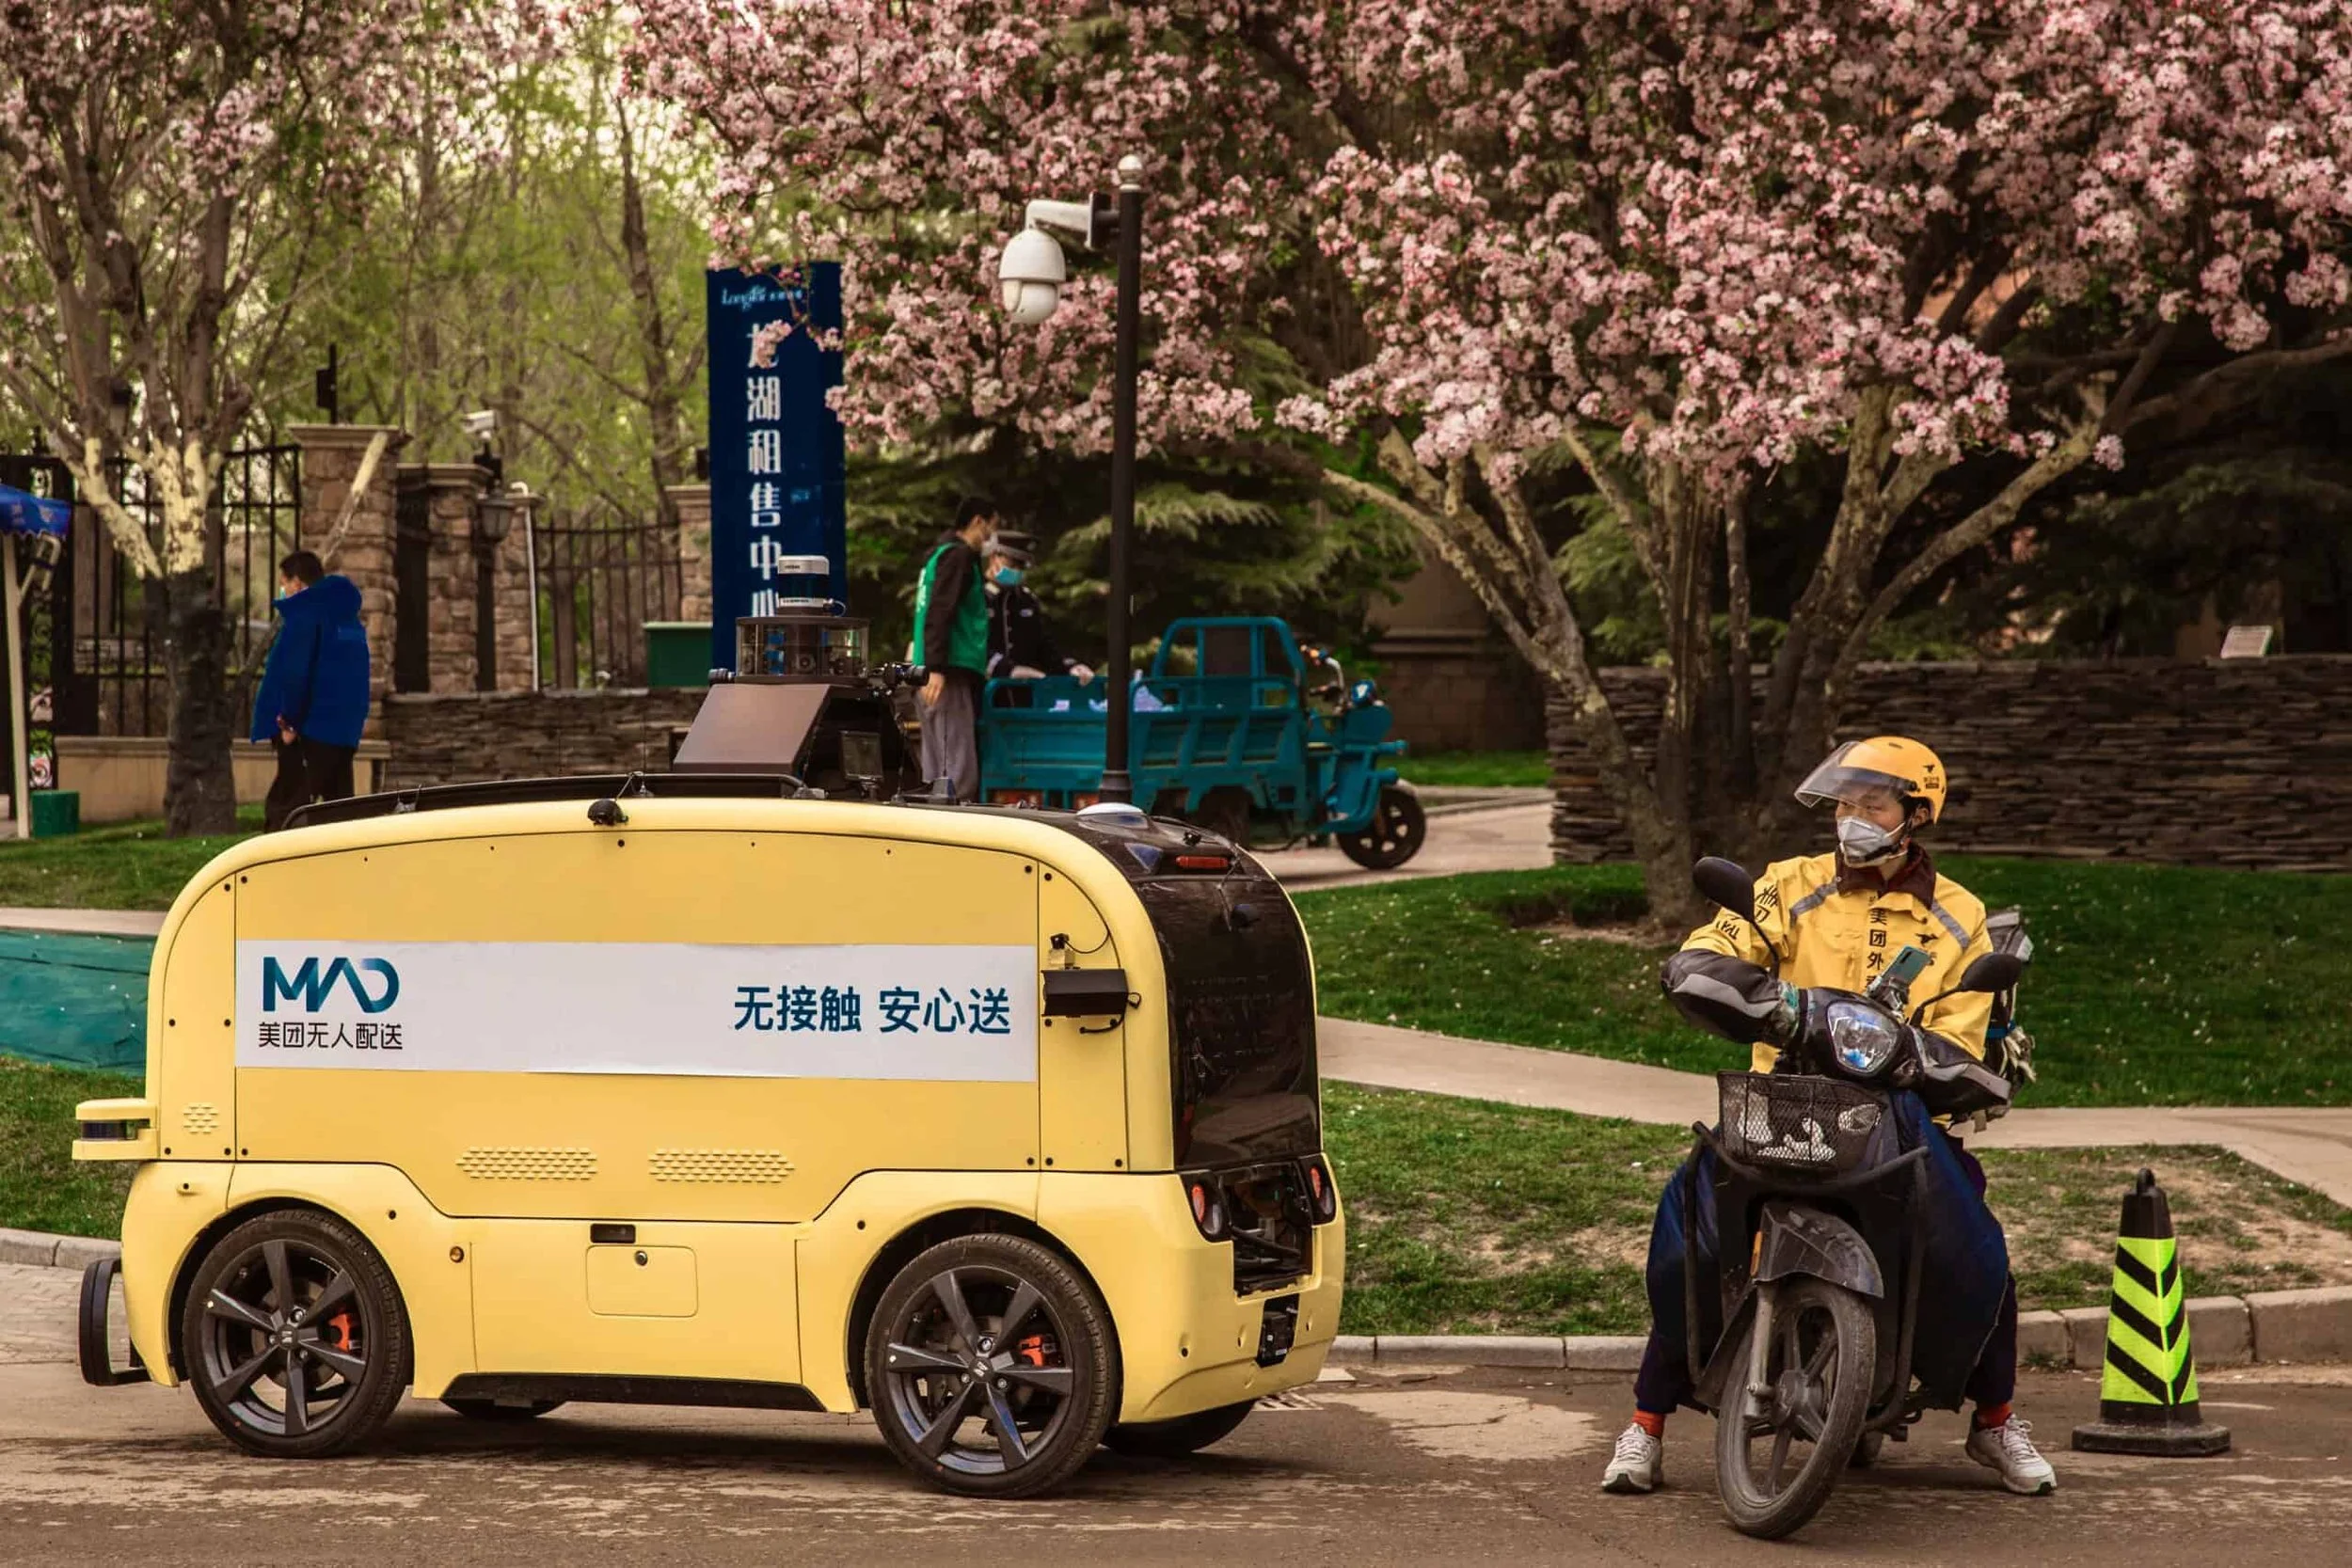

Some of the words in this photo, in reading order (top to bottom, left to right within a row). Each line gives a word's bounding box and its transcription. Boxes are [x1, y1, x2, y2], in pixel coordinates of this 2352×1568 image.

[262, 956, 400, 1013] MAD
[734, 985, 862, 1033] 无接触
[879, 986, 1010, 1034] 安心送
[259, 1022, 403, 1050] 美团无人配送
